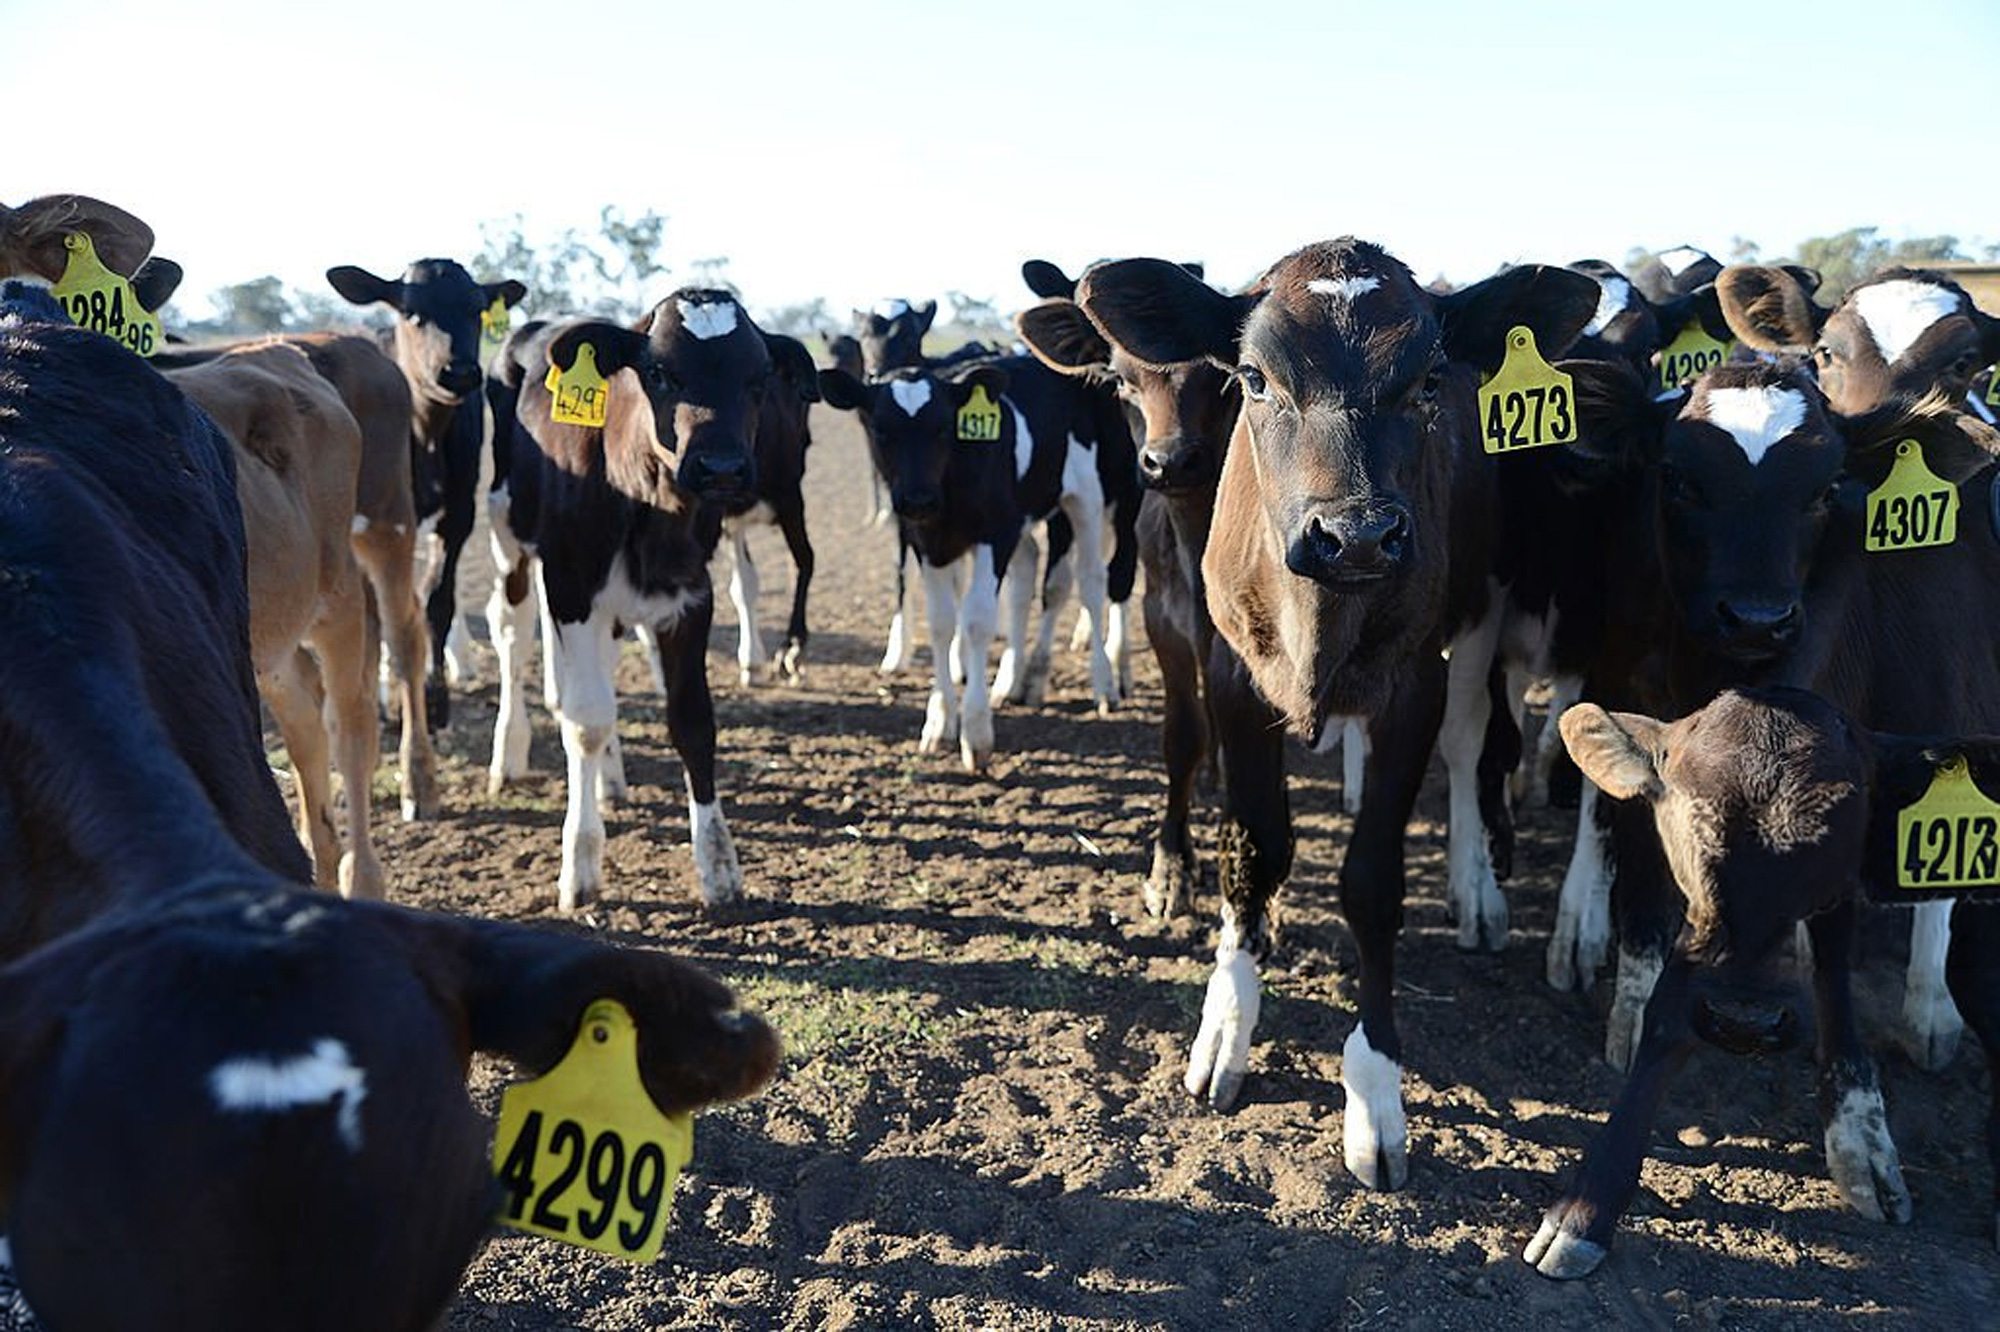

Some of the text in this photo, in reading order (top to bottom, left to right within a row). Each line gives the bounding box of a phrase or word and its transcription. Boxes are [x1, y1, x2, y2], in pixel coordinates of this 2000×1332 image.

[960, 413, 997, 438] 4317
[1487, 385, 1571, 449] 4273
[1870, 490, 1950, 547] 4307
[500, 1110, 665, 1252] 4299
